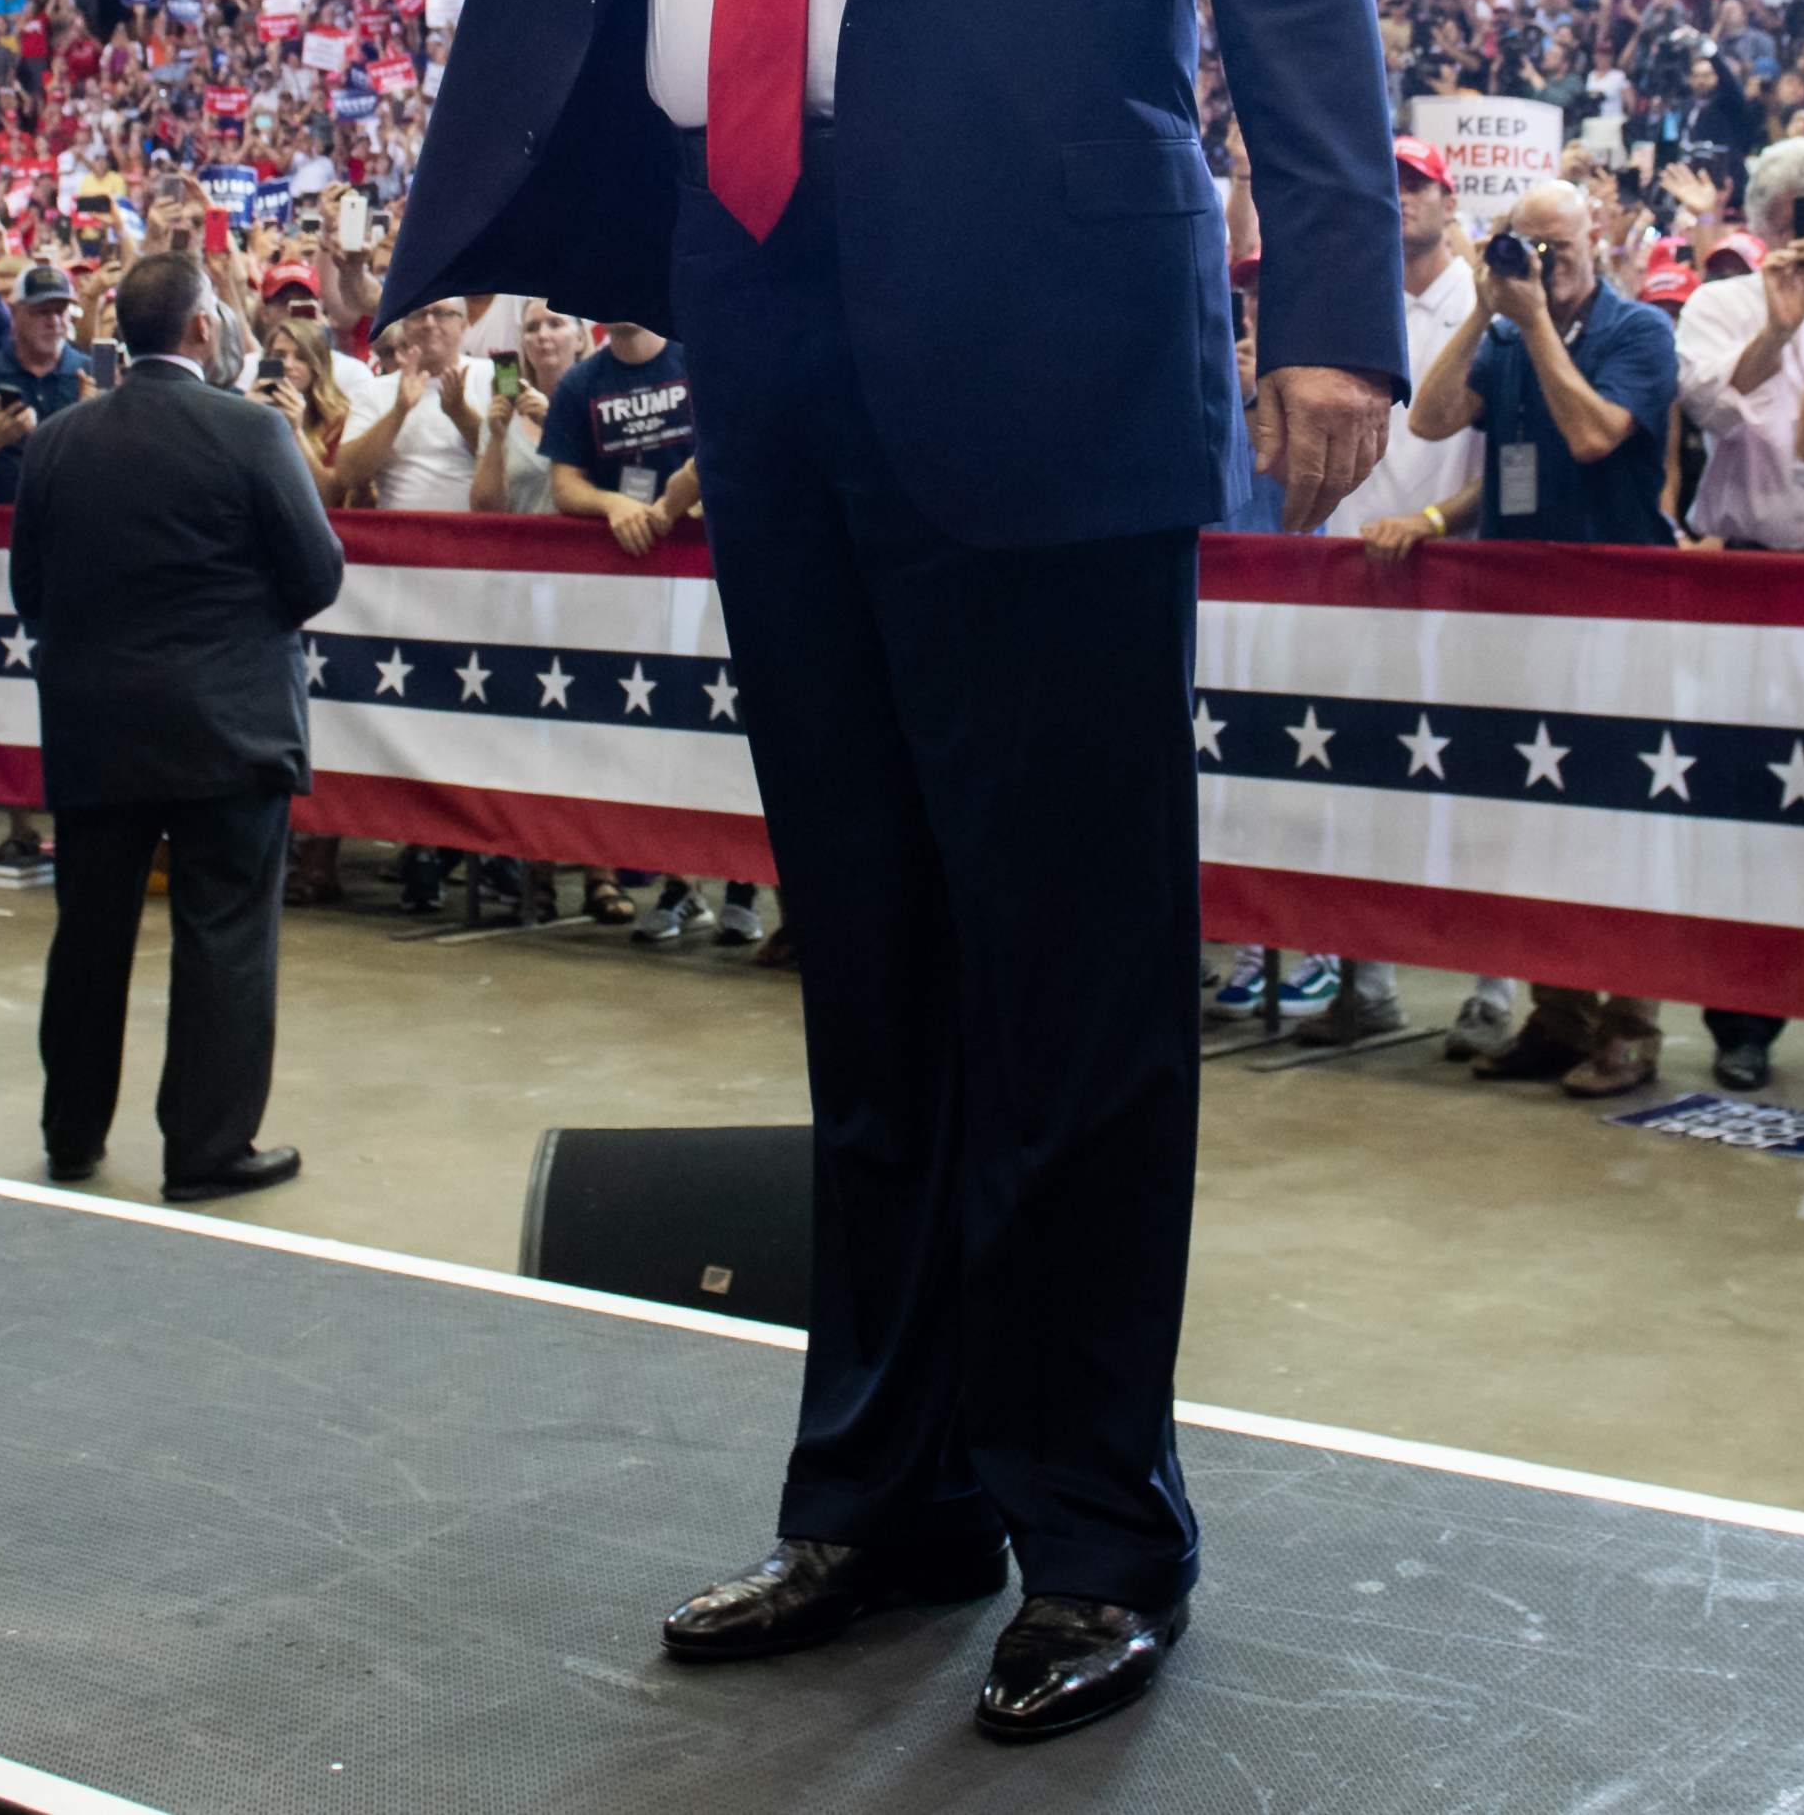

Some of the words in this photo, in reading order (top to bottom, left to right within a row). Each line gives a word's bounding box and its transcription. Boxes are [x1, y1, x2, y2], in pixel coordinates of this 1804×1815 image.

[1458, 116, 1528, 136] KEEP
[1444, 143, 1553, 171] MERICA
[597, 384, 687, 425] TRUMP
